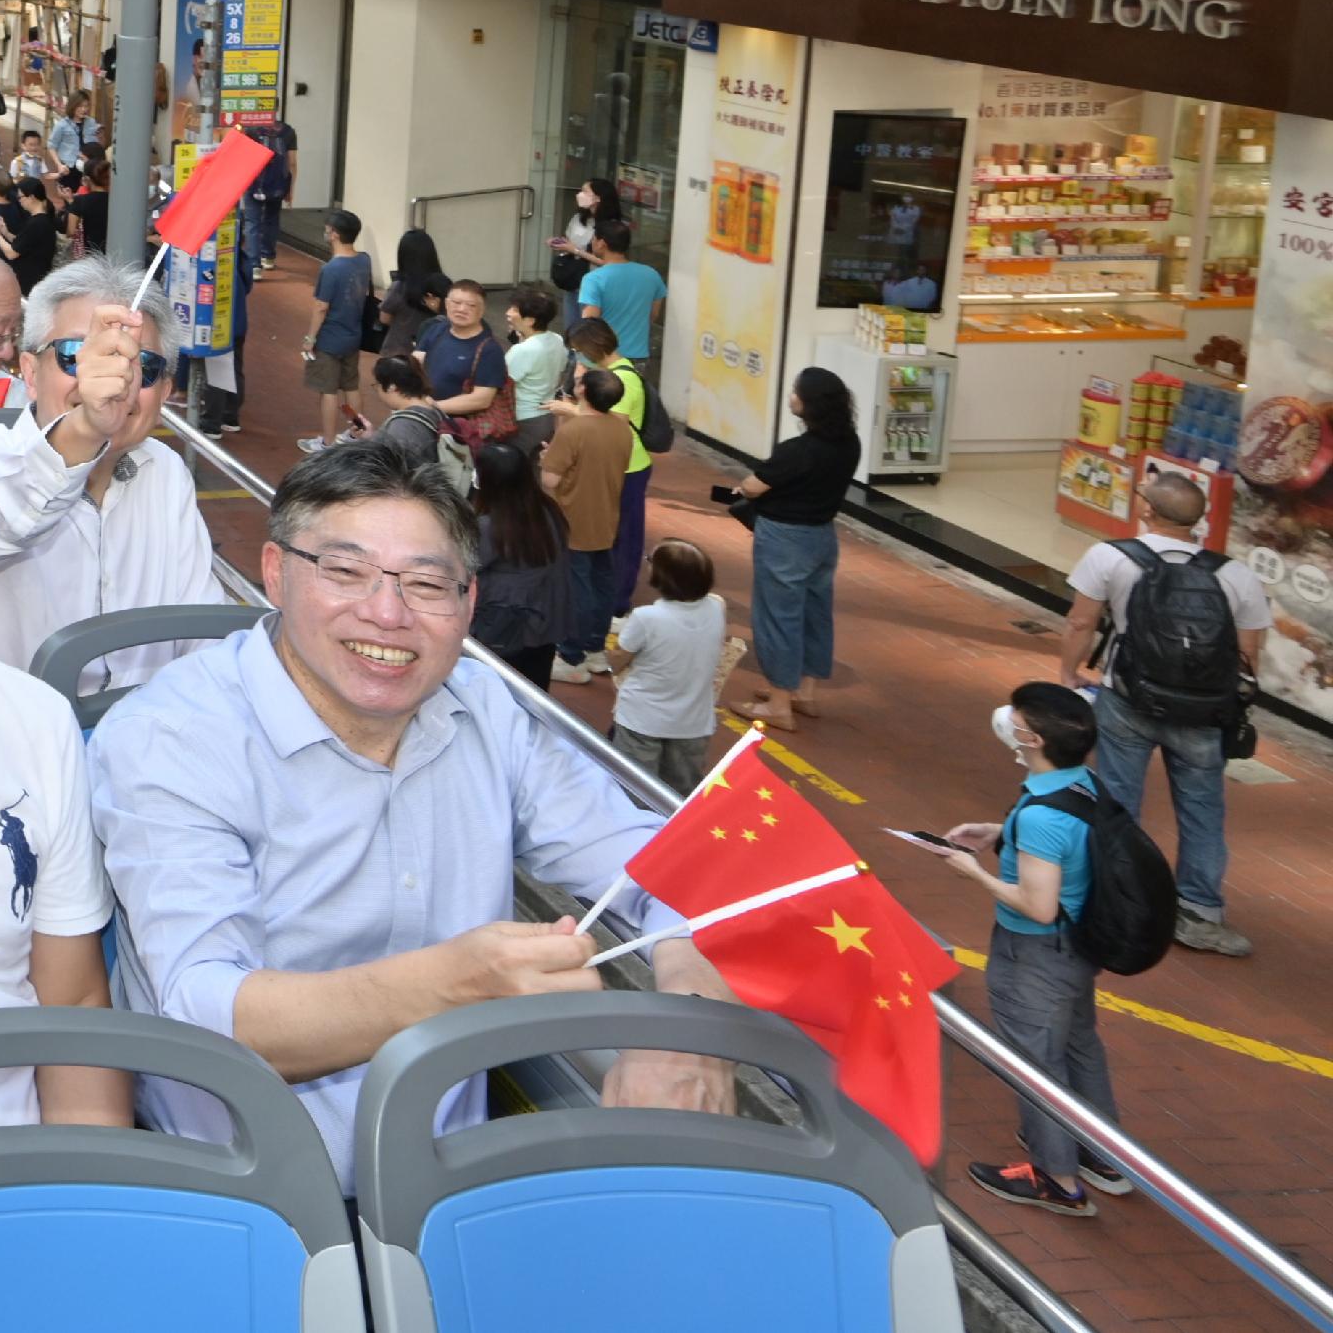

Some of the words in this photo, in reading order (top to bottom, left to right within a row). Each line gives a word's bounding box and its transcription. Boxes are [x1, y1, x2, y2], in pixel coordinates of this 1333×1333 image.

[226, 3, 242, 15] 5X
[230, 18, 238, 29] 8
[225, 32, 240, 45] 26
[1278, 233, 1333, 261] 100%
